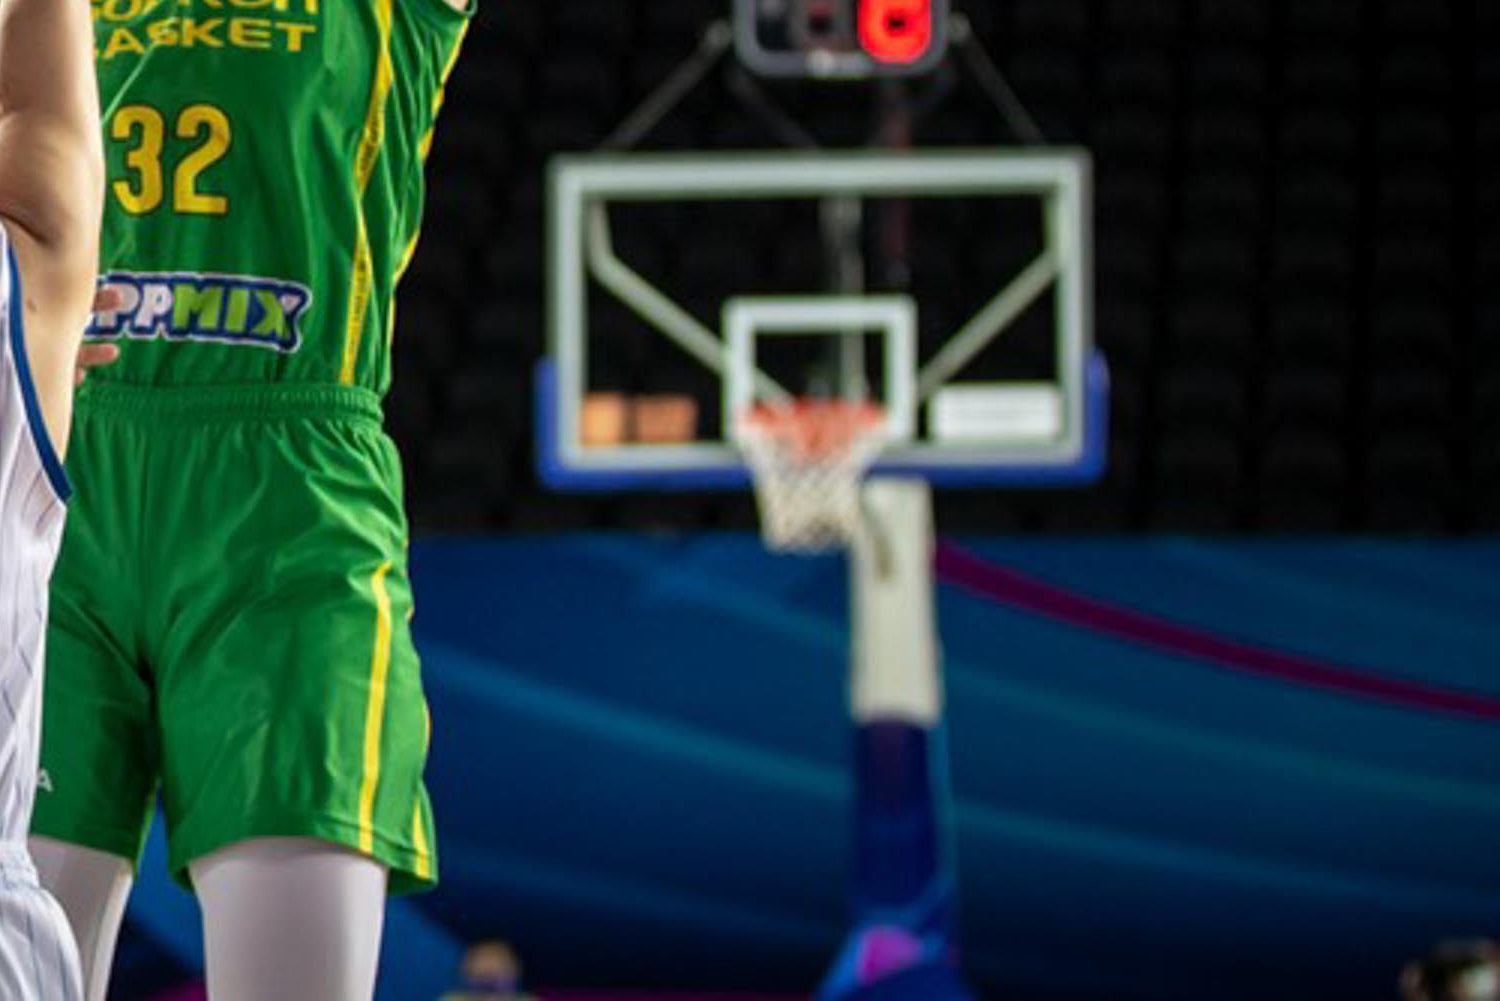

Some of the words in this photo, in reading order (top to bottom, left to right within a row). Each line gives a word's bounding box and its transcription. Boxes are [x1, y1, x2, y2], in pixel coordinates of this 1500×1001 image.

[95, 16, 317, 59] ASKET
[110, 104, 232, 215] 32
[86, 282, 301, 340] PPMIX
